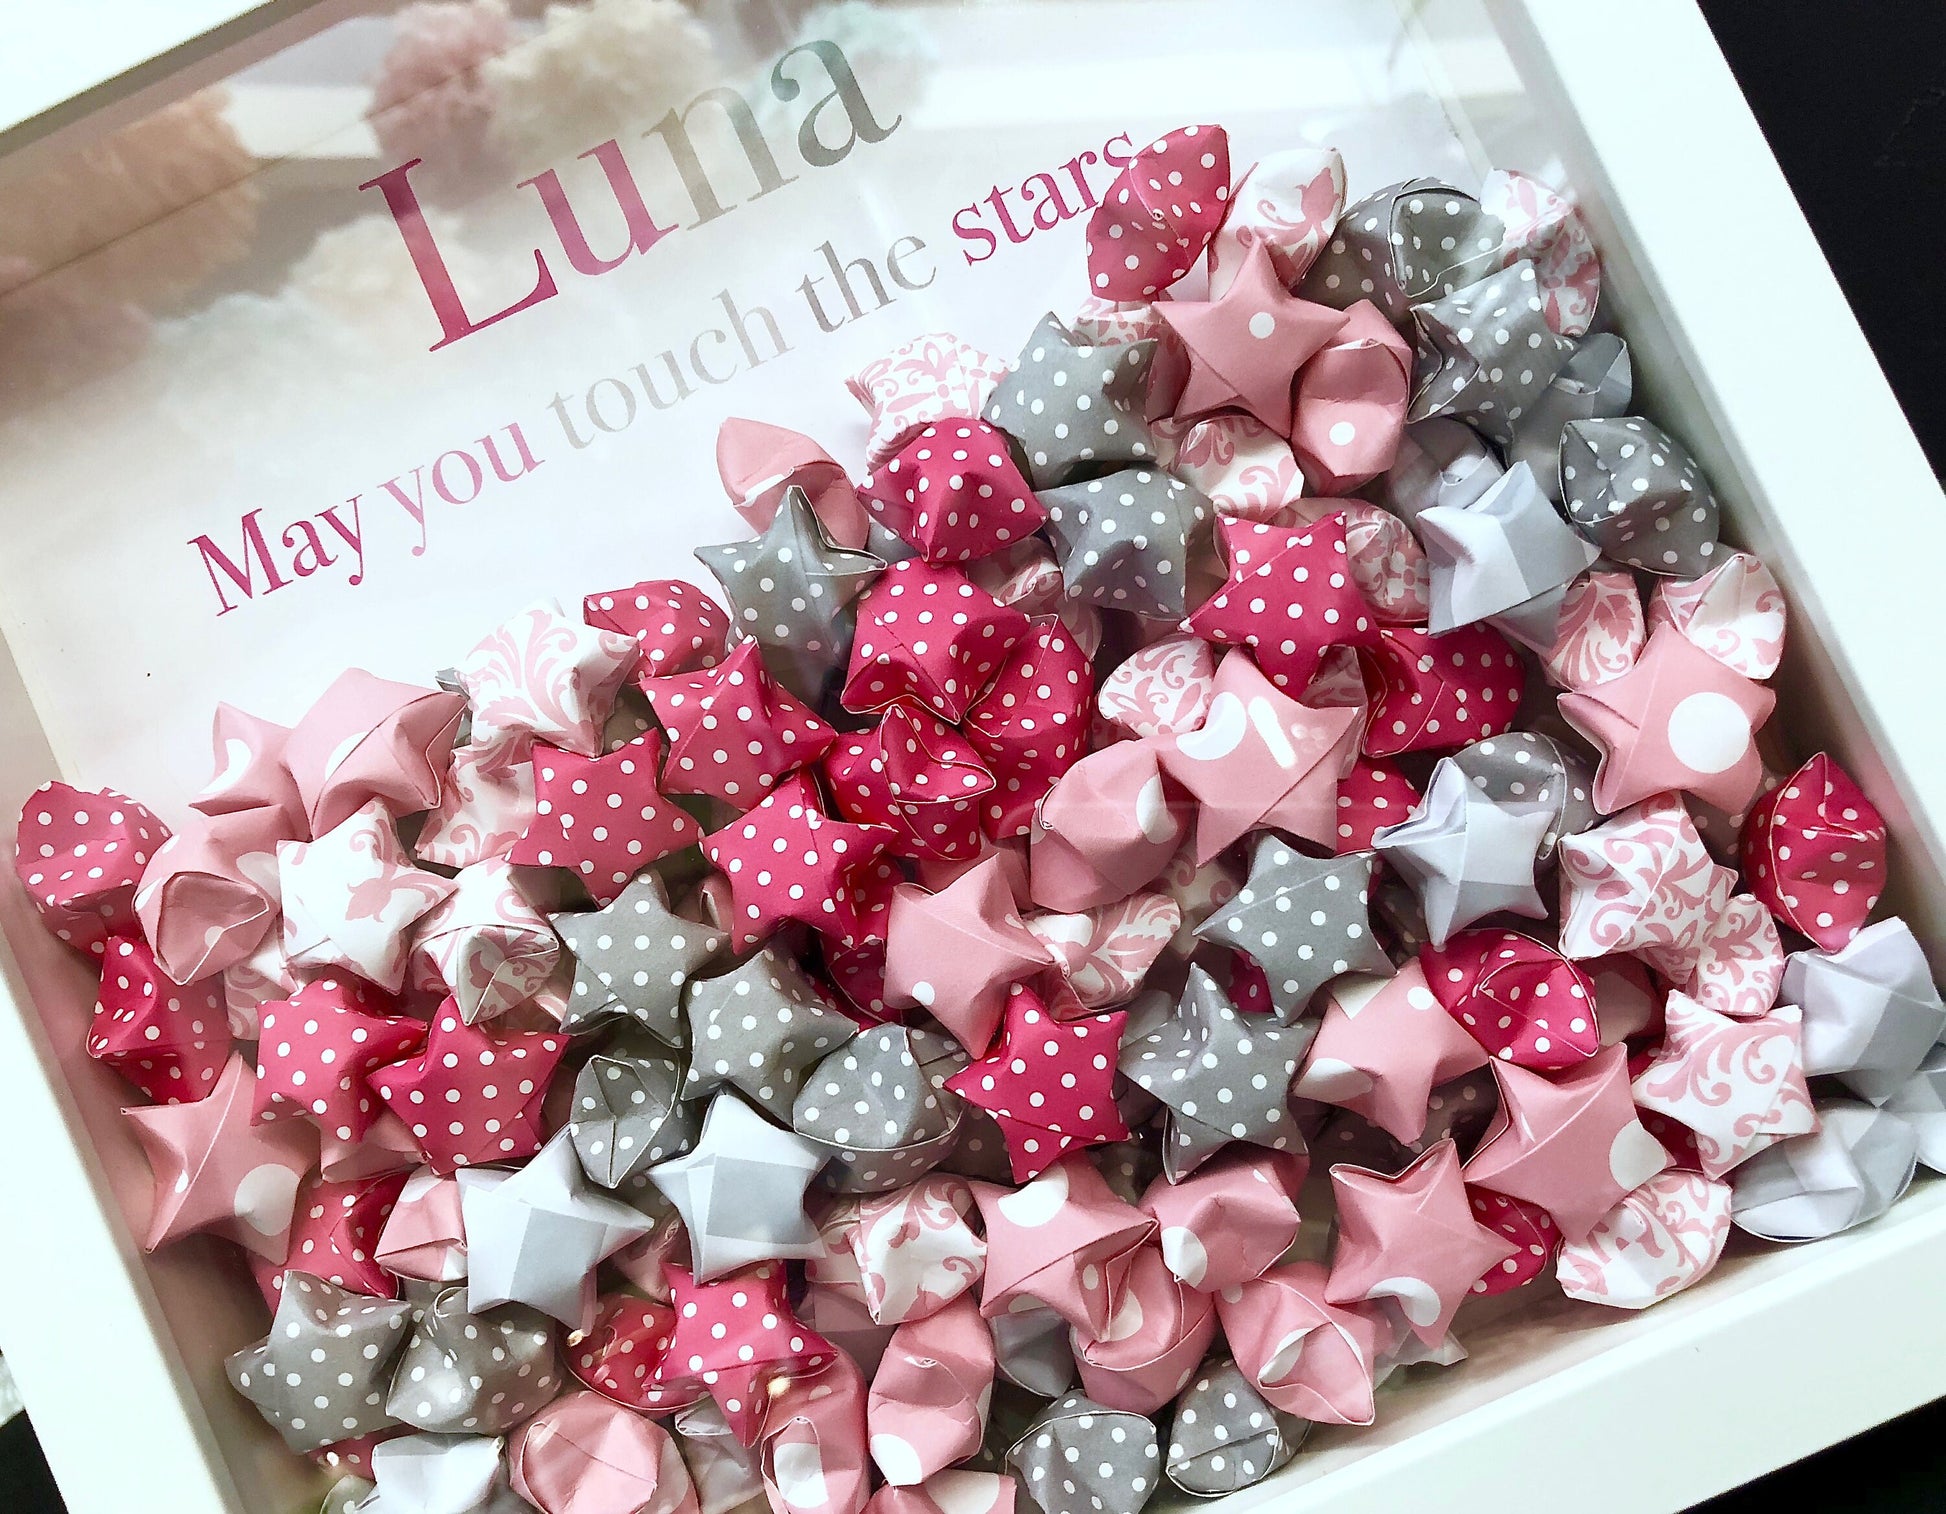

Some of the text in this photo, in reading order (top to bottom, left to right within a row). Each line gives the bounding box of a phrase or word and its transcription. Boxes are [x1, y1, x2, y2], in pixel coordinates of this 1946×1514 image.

[358, 39, 902, 353] Luna
[186, 494, 364, 617] May
[377, 420, 546, 557] you
[547, 289, 795, 449] touch
[795, 234, 937, 333] the
